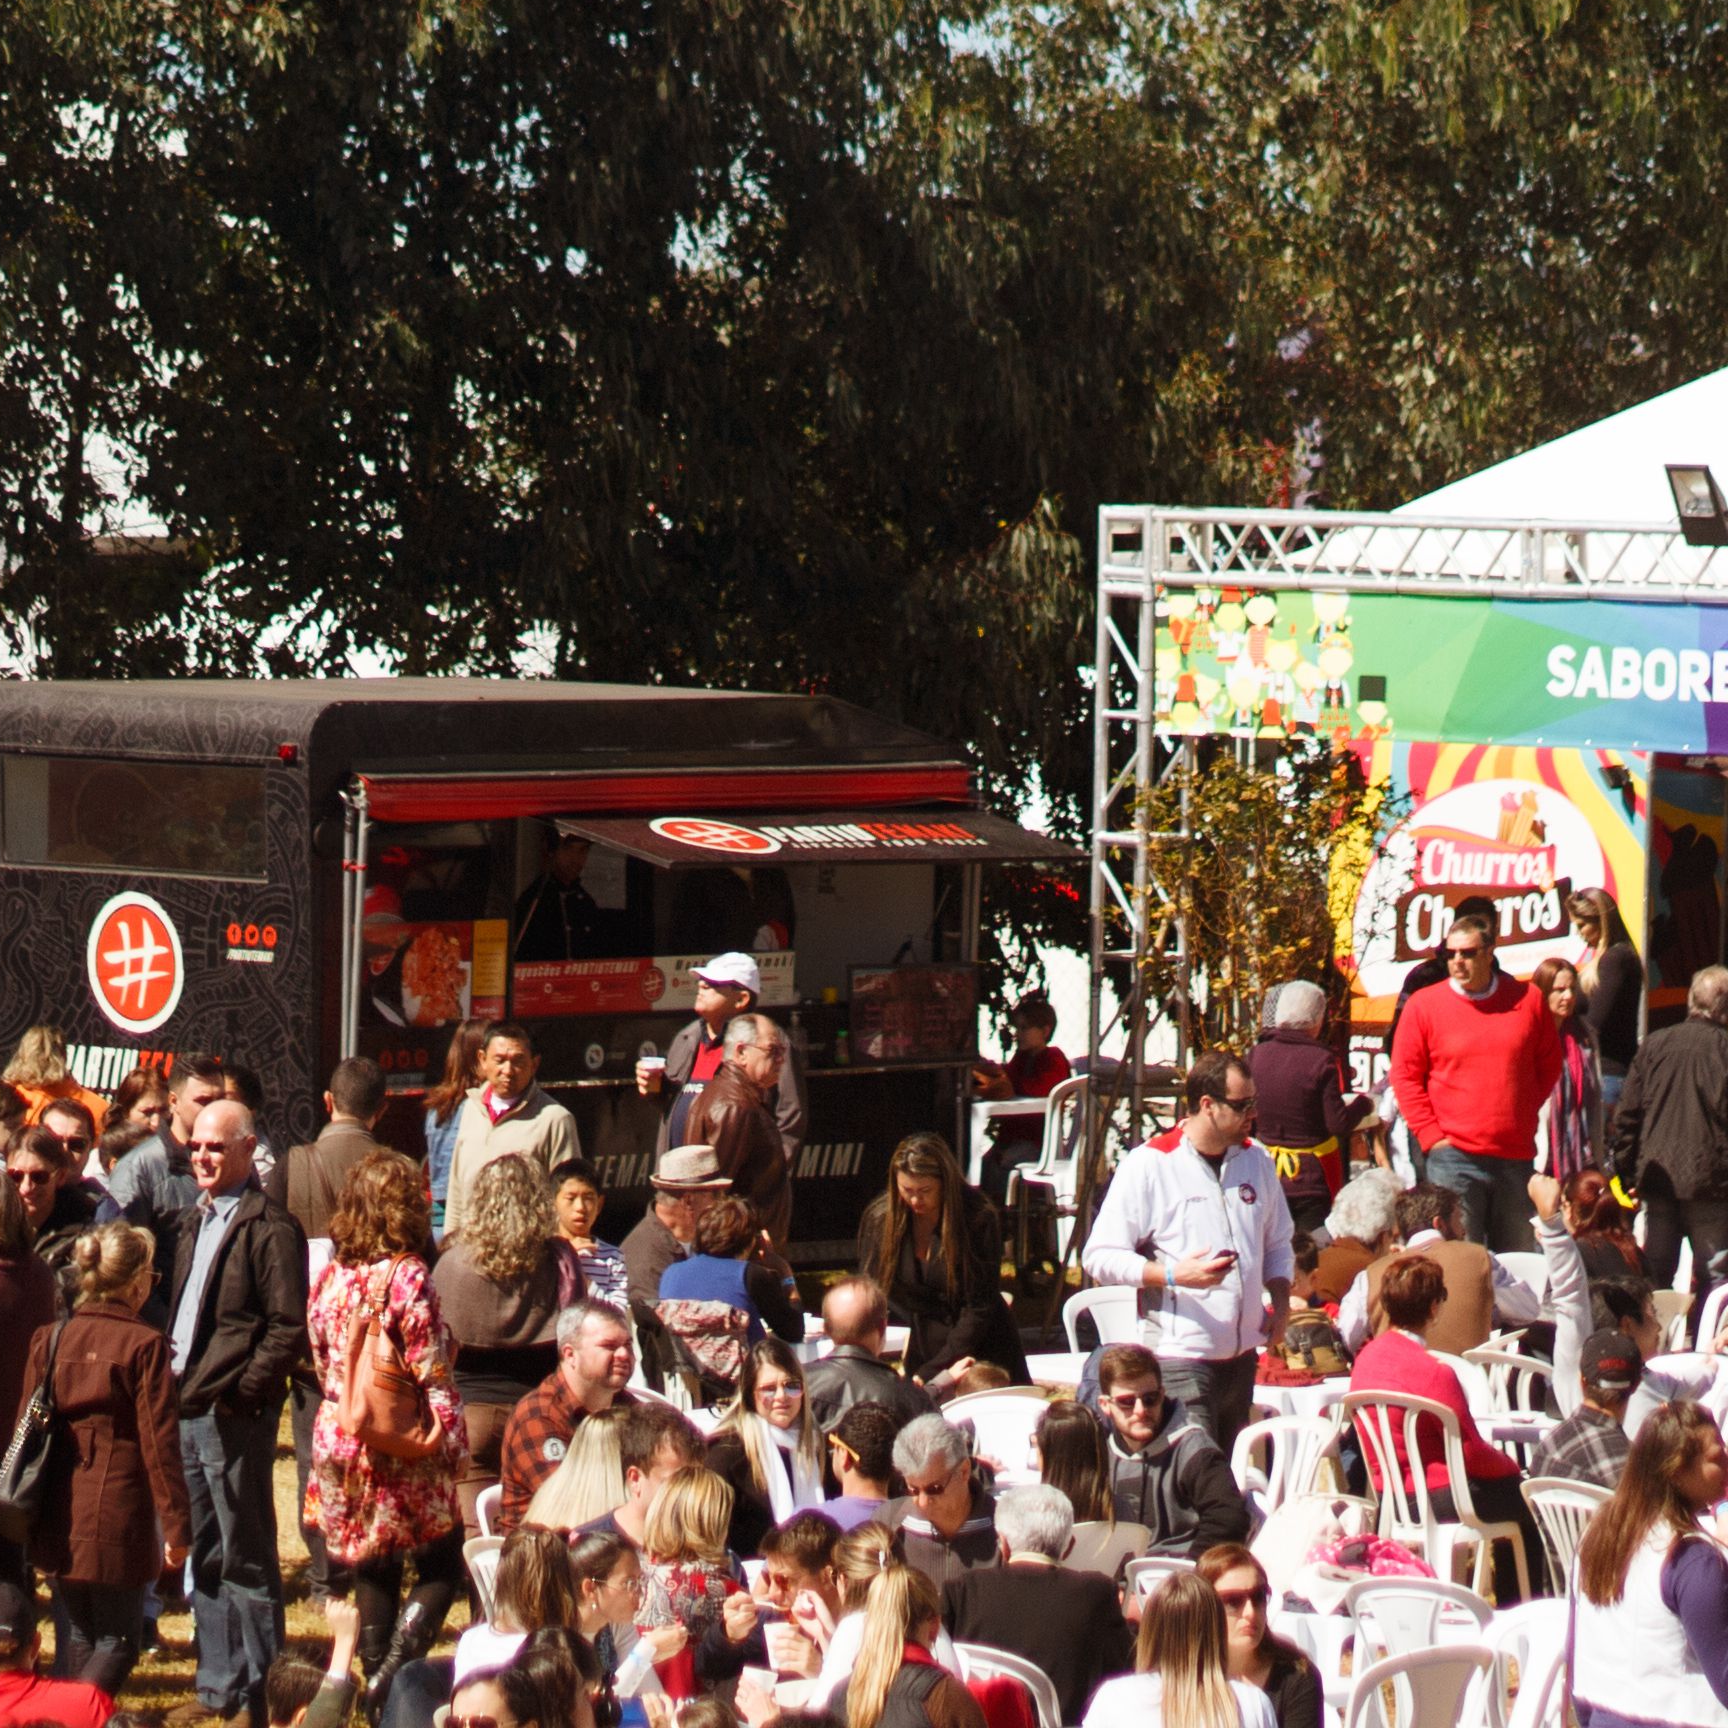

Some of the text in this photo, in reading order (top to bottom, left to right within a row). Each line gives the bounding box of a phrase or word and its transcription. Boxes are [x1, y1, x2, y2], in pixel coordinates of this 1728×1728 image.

[758, 823, 978, 843] PARTIUTEMAKI
[1421, 837, 1550, 886] Churros
[1404, 888, 1562, 952] Chros
